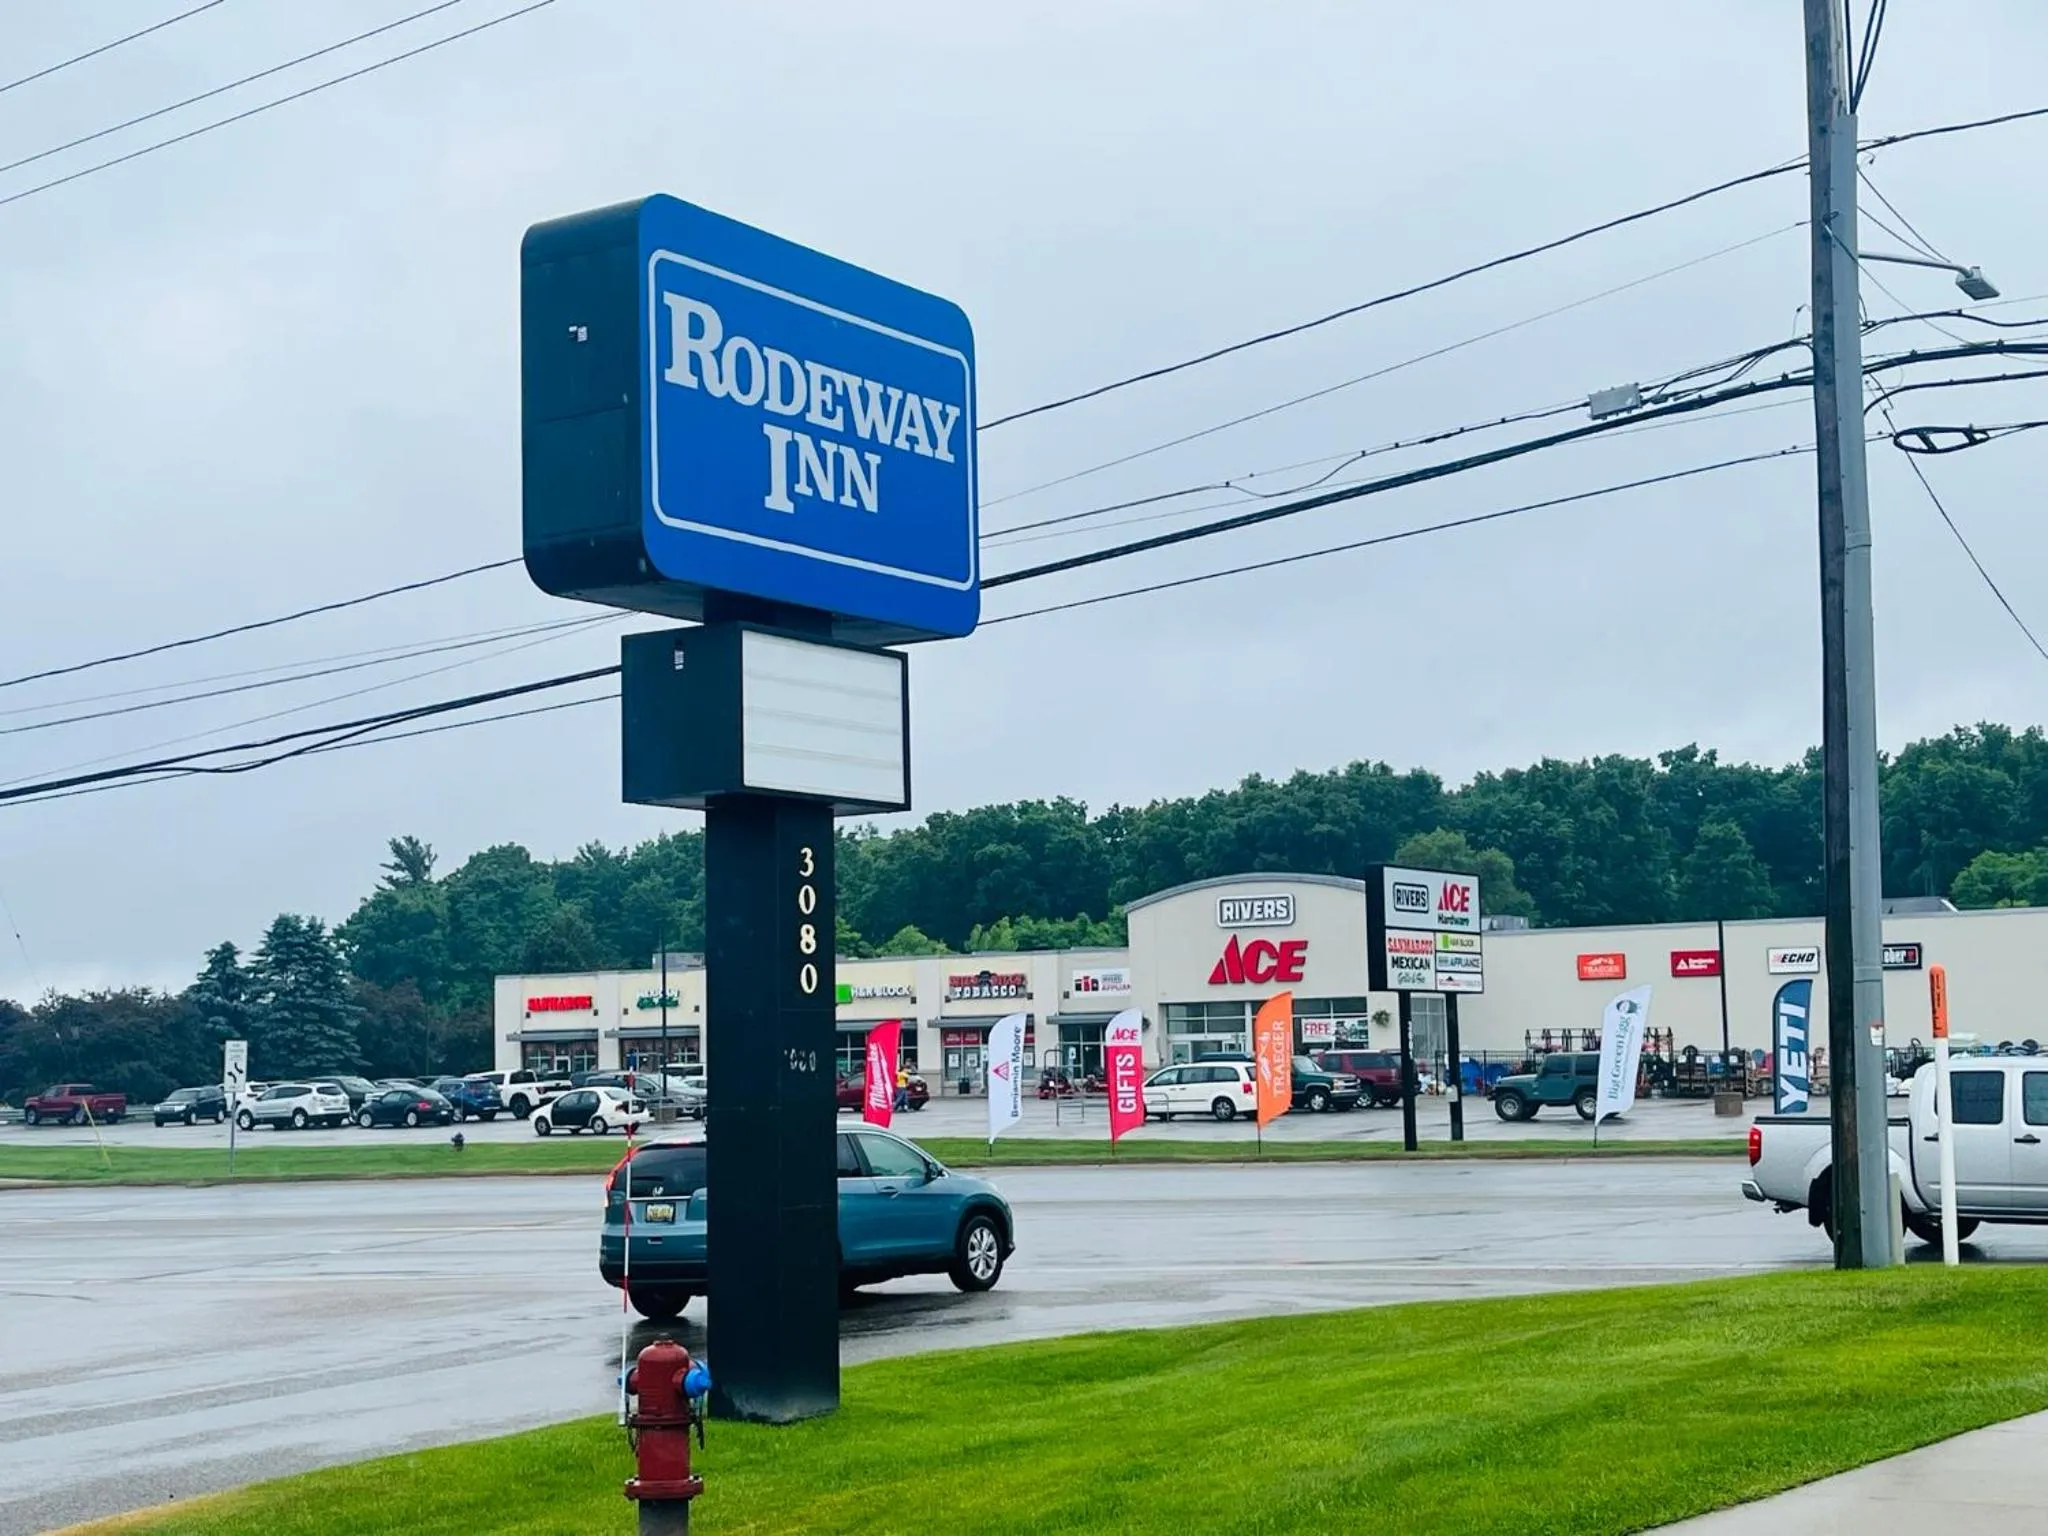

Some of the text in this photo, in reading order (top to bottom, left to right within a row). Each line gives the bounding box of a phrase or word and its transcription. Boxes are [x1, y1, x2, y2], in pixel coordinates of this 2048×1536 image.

[663, 291, 960, 463] RODEWAY
[763, 423, 881, 514] INN
[1222, 899, 1289, 922] RIVERS
[1396, 889, 1427, 908] RIVERS
[1437, 880, 1470, 912] ACE
[1208, 934, 1308, 985] ACE
[1391, 955, 1431, 970] MEXICAN
[1781, 953, 1815, 964] ECHO
[954, 985, 1017, 998] TOBACCO
[1112, 1028, 1138, 1040] ACE
[1304, 1022, 1331, 1035] FREE
[1616, 1016, 1631, 1039] Egg
[1011, 1025, 1022, 1117] Benjamin Moore
[1272, 1019, 1285, 1097] TRAEGER
[1611, 1040, 1624, 1078] Green
[1779, 1000, 1809, 1110] YETI
[1116, 1053, 1137, 1113] GIFTS
